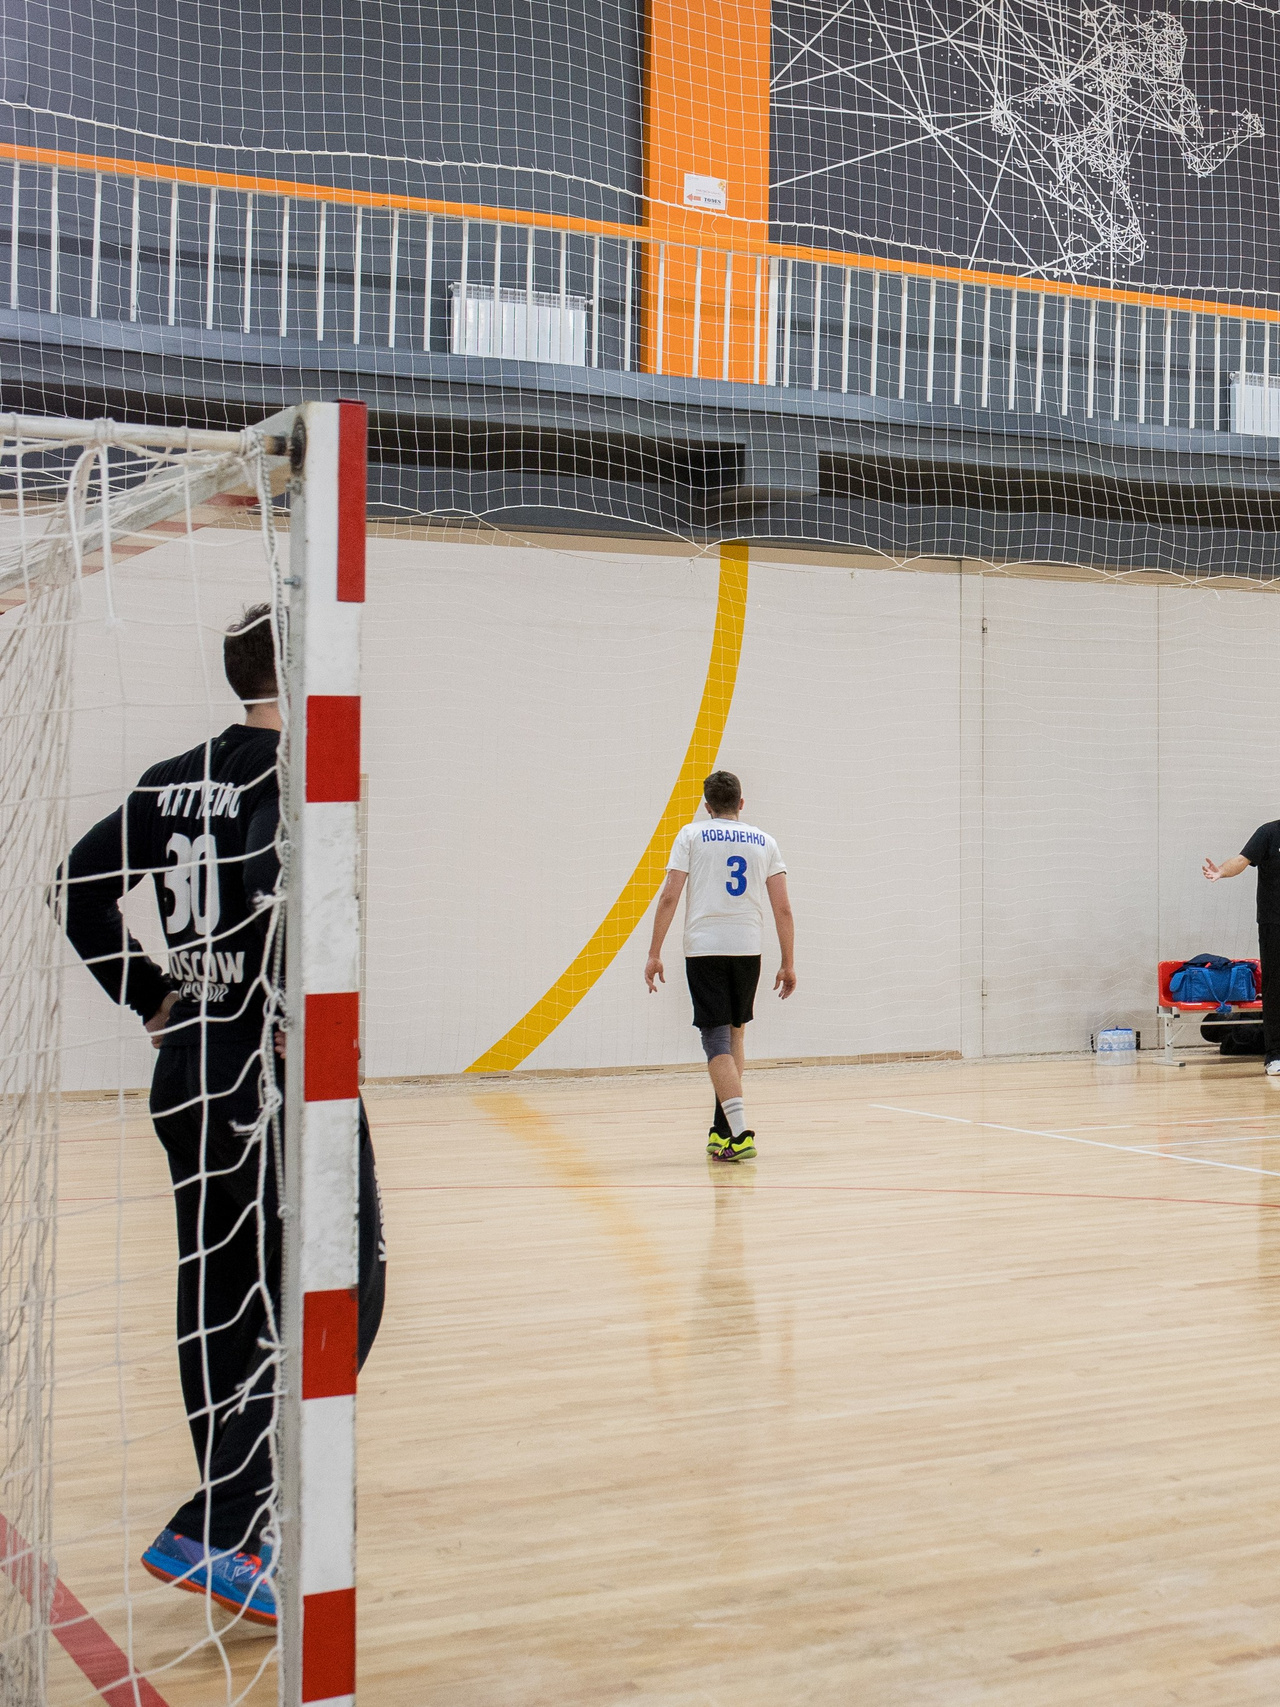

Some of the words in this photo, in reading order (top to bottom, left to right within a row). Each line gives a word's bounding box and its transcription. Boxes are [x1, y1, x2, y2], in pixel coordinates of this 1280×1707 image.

[702, 829, 766, 847] КОВАЛЕНКО
[164, 832, 221, 936] 30
[726, 855, 748, 897] 3
[169, 950, 245, 984] OSCOW
